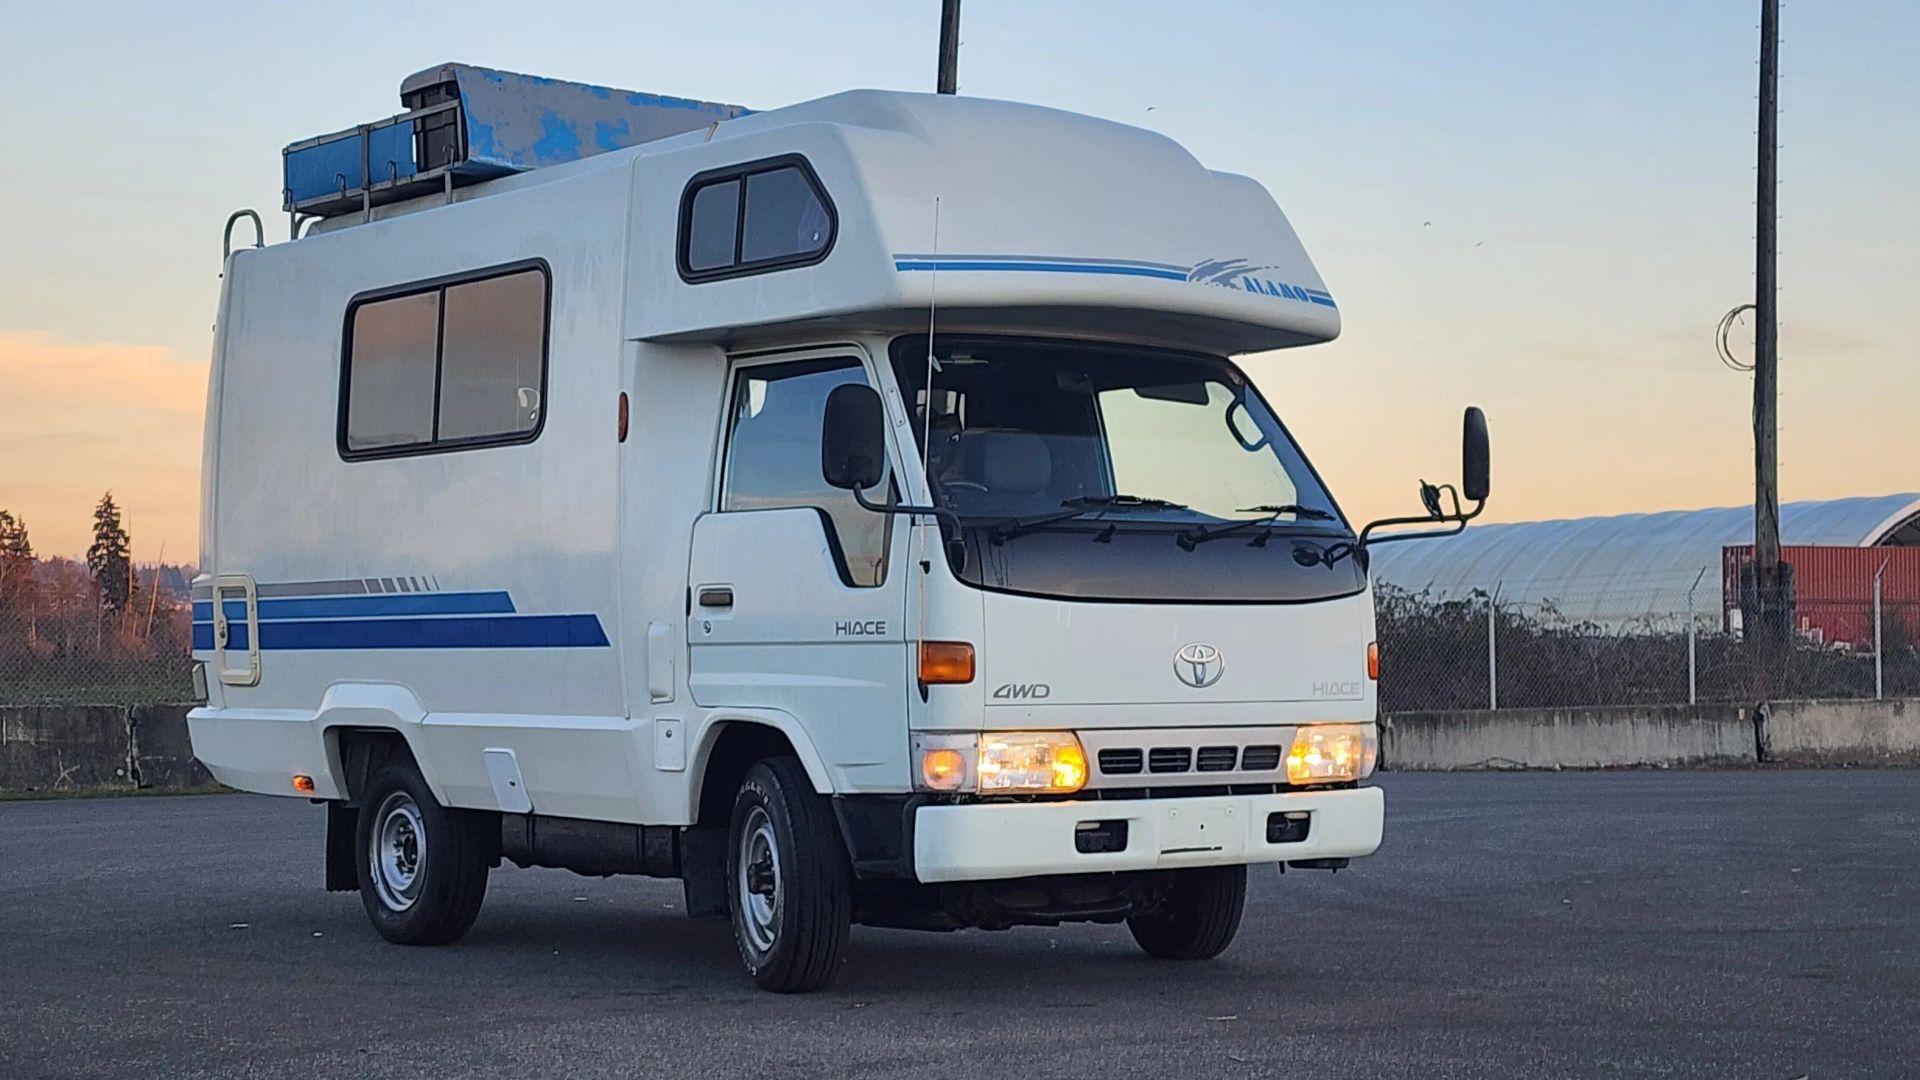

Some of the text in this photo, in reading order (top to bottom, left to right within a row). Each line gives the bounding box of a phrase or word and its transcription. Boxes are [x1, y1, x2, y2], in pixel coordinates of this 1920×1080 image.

[1242, 275, 1309, 302] ALAMO
[835, 621, 886, 636] HIACE
[992, 683, 1051, 699] 4WD
[1312, 682, 1360, 697] HIACE
